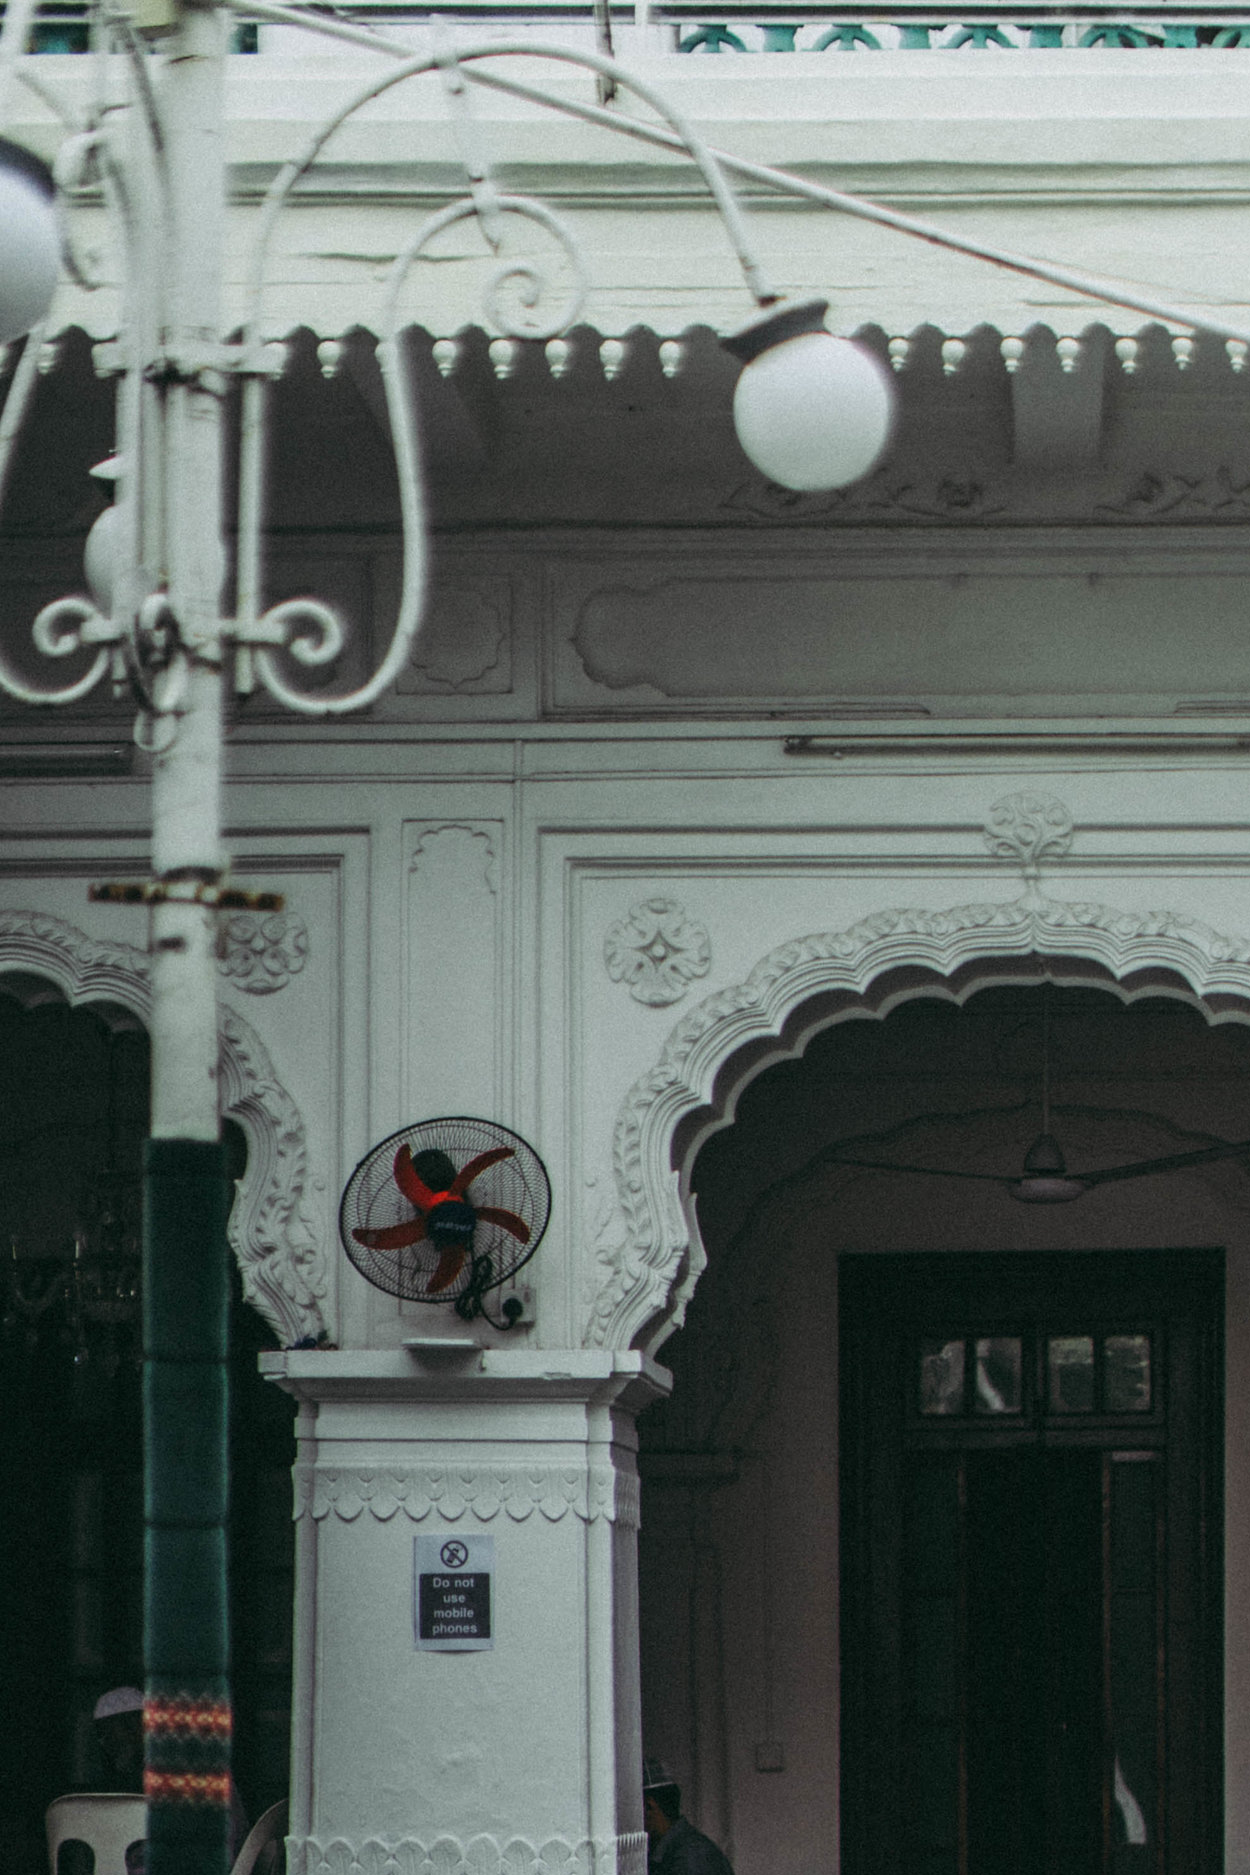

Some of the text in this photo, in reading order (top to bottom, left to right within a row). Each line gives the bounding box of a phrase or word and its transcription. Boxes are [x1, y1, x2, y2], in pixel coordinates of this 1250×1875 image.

[433, 1577, 475, 1588] Do not
[443, 1594, 466, 1603] use
[433, 1608, 475, 1618] mobile
[432, 1623, 478, 1636] phones
